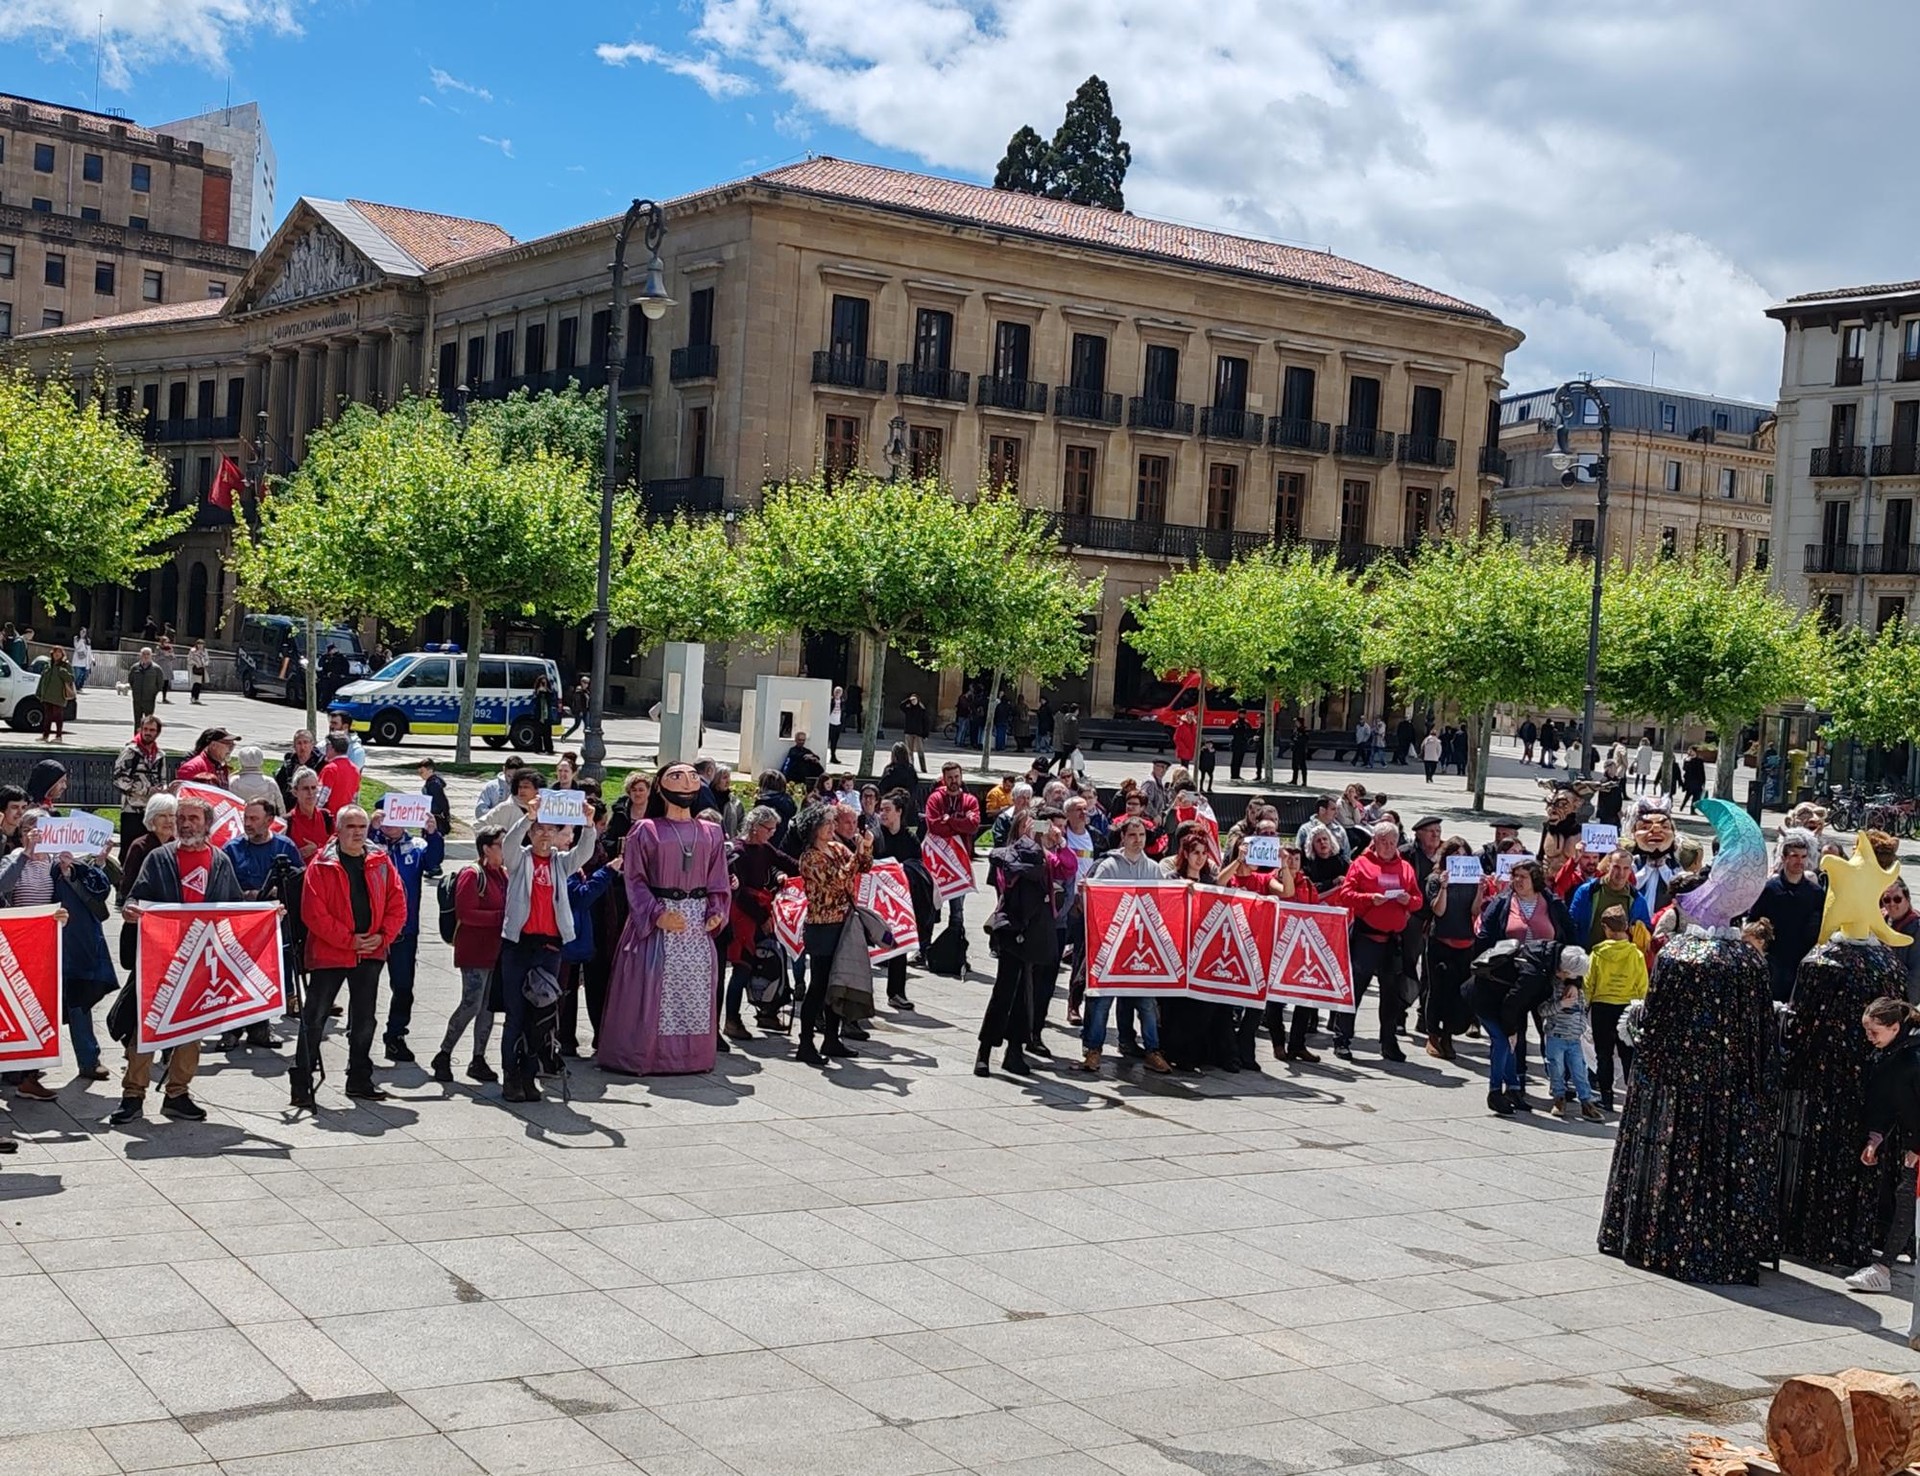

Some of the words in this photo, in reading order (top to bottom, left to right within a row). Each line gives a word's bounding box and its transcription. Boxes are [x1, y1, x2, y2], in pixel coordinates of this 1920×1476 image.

[1731, 510, 1763, 523] BANCO
[474, 708, 492, 719] 092
[390, 798, 426, 821] Eneritz
[543, 795, 581, 816] Arbizu
[1201, 899, 1225, 931] TENSION
[175, 917, 207, 961] TENSION
[216, 918, 245, 957] AUTOPISTA
[1089, 963, 1101, 978] NO
[1095, 942, 1111, 966] LINEA
[1105, 924, 1119, 944] ALTA
[1112, 891, 1133, 925] TENSION
[165, 959, 186, 987] ALTA
[9, 968, 50, 1034] ELEKTRIKORIK
[38, 1025, 57, 1045] EZ
[151, 982, 174, 1015] LINEA
[144, 1008, 160, 1030] NO
